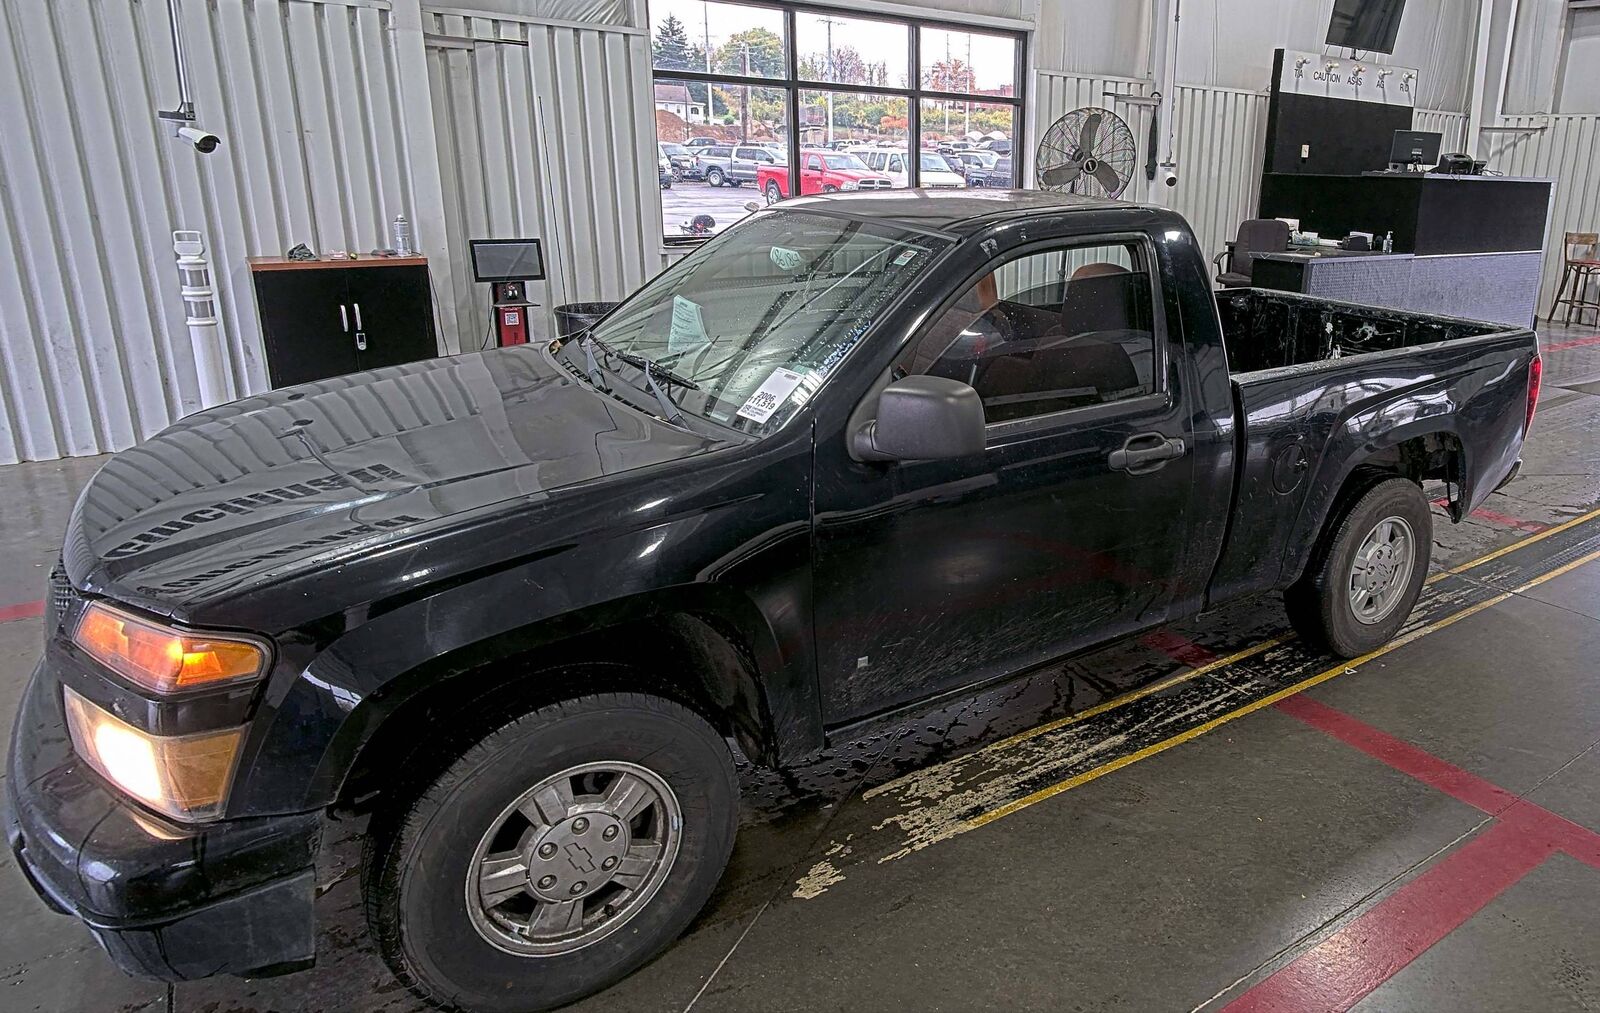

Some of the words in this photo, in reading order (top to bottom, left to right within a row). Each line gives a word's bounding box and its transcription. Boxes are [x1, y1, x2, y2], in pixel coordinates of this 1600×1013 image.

[1313, 71, 1341, 83] CAUTION
[757, 391, 777, 402] 2006
[748, 396, 776, 410] 111,519
